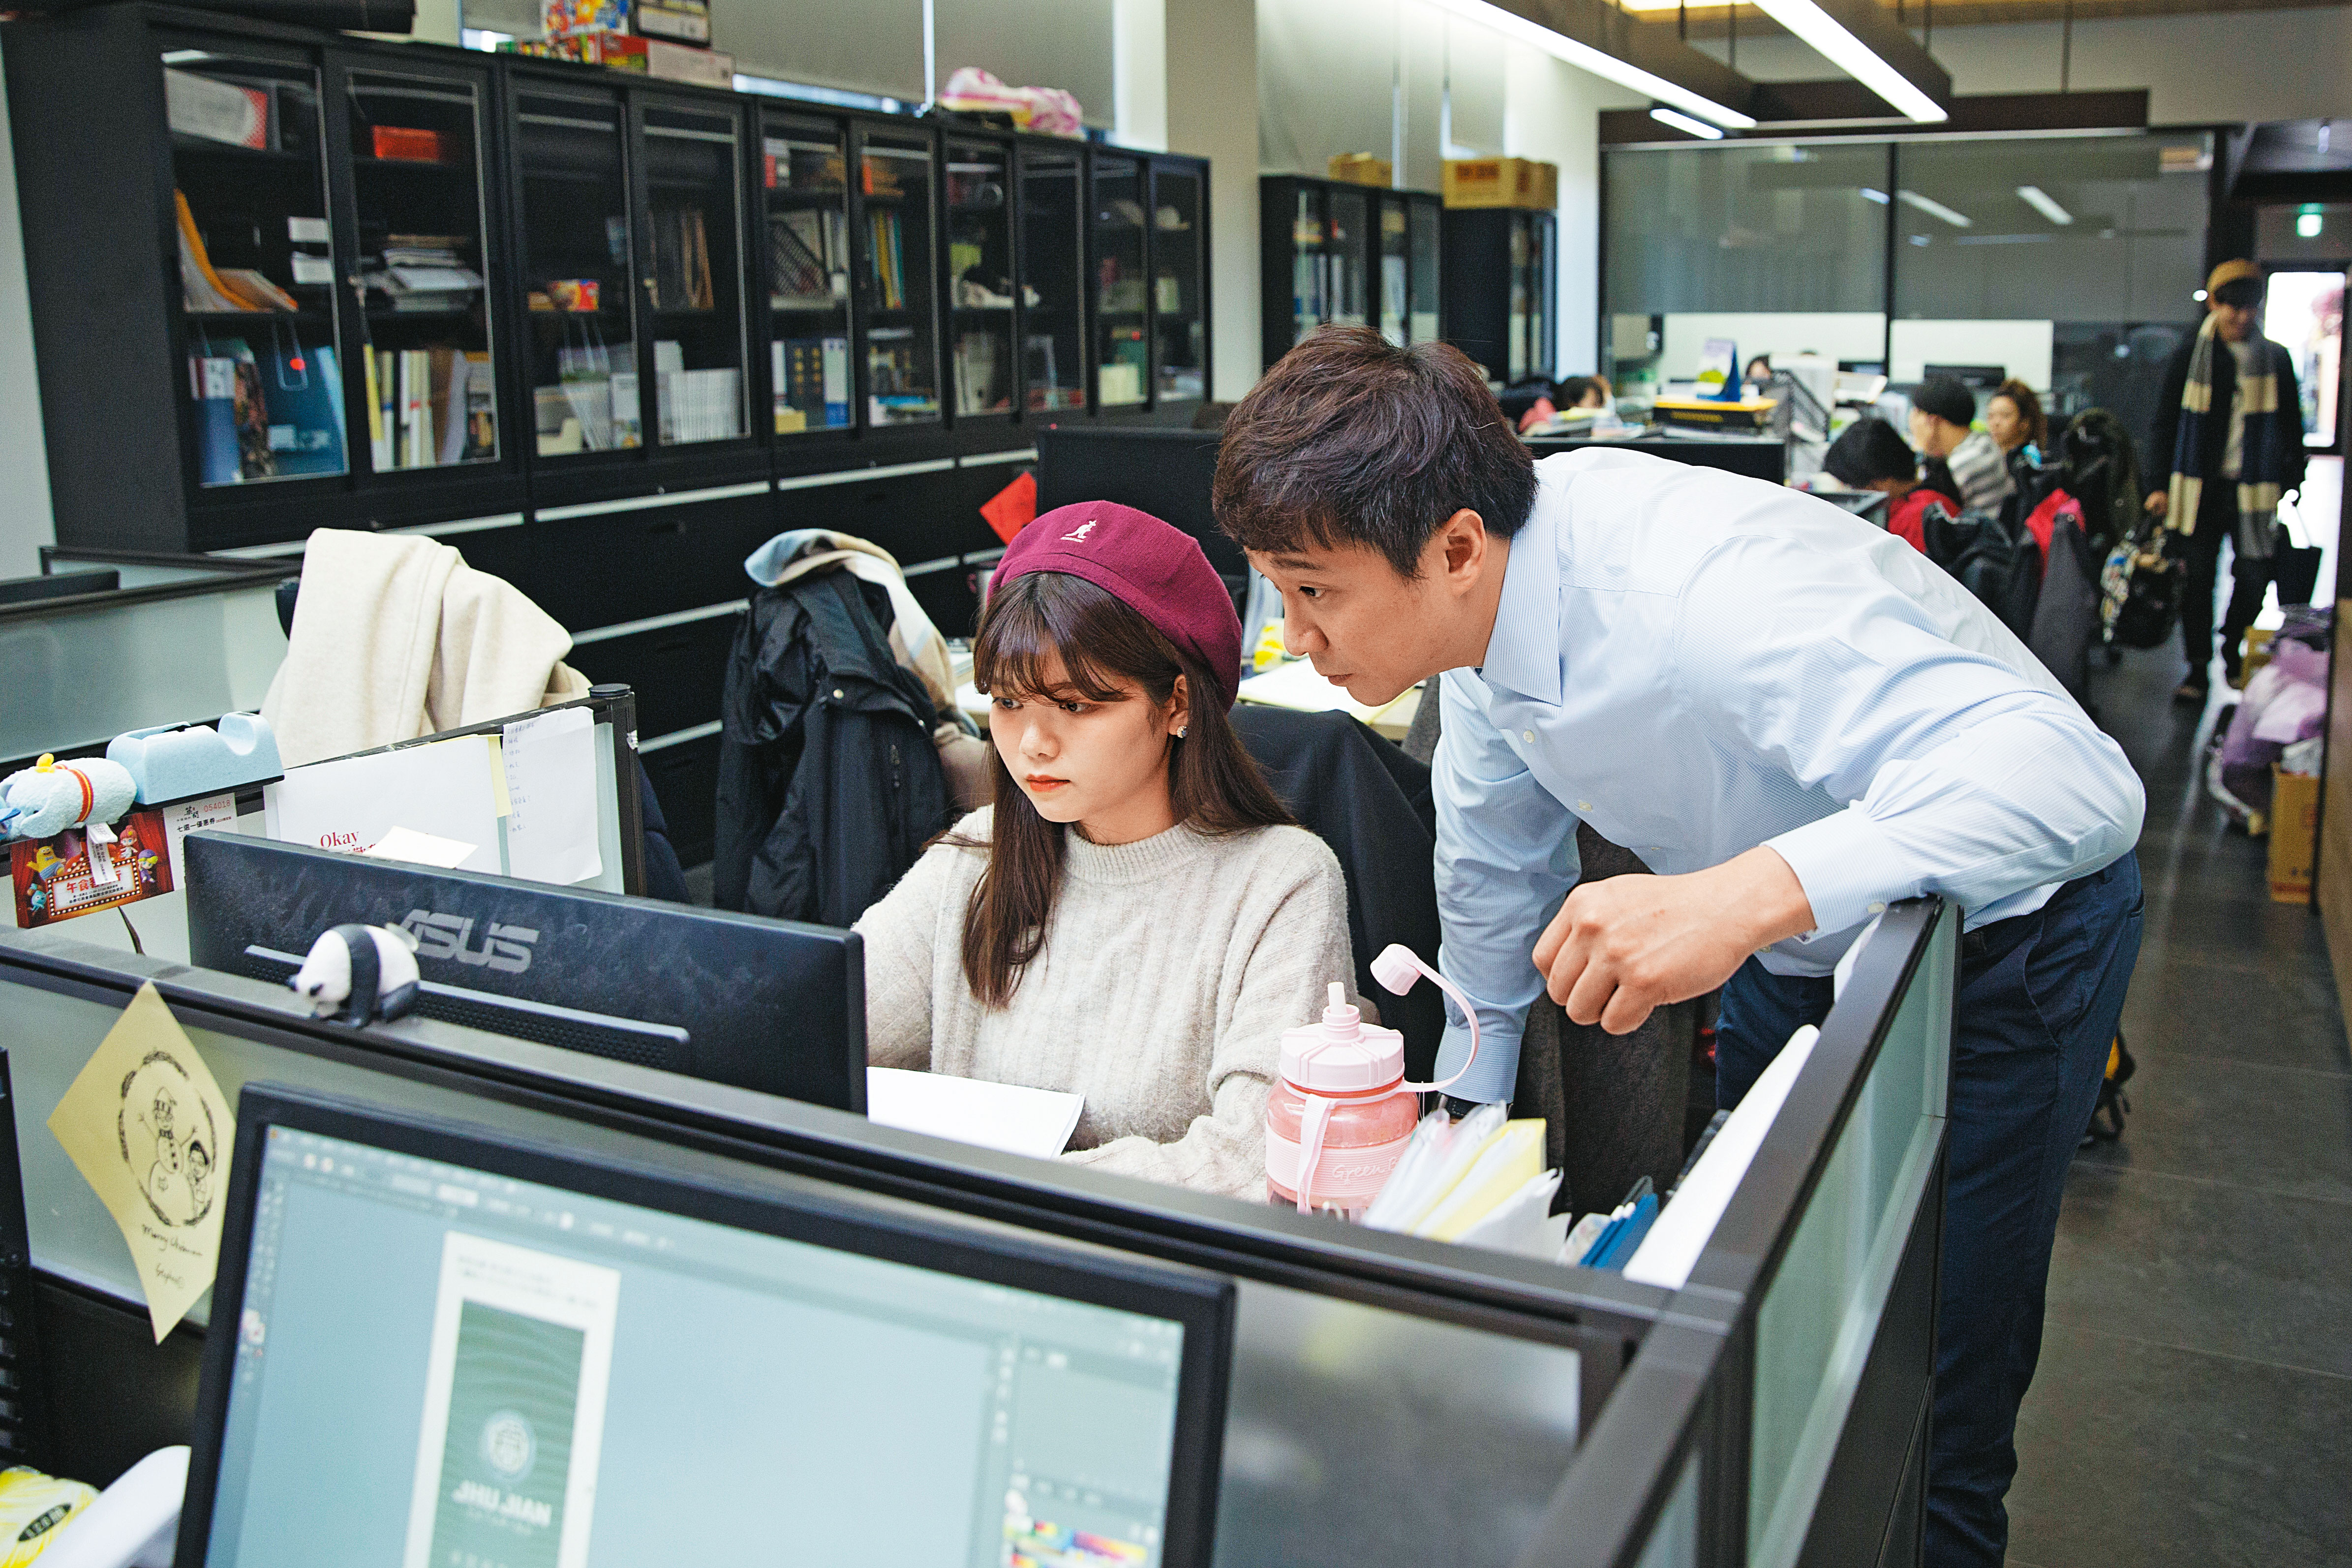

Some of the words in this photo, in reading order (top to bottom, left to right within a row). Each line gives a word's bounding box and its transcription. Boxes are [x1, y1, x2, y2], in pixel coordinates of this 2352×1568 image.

[177, 817, 215, 832] 七選一優惠券
[320, 831, 359, 848] Okay
[399, 909, 540, 974] ASUS
[1331, 1163, 1385, 1183] Green
